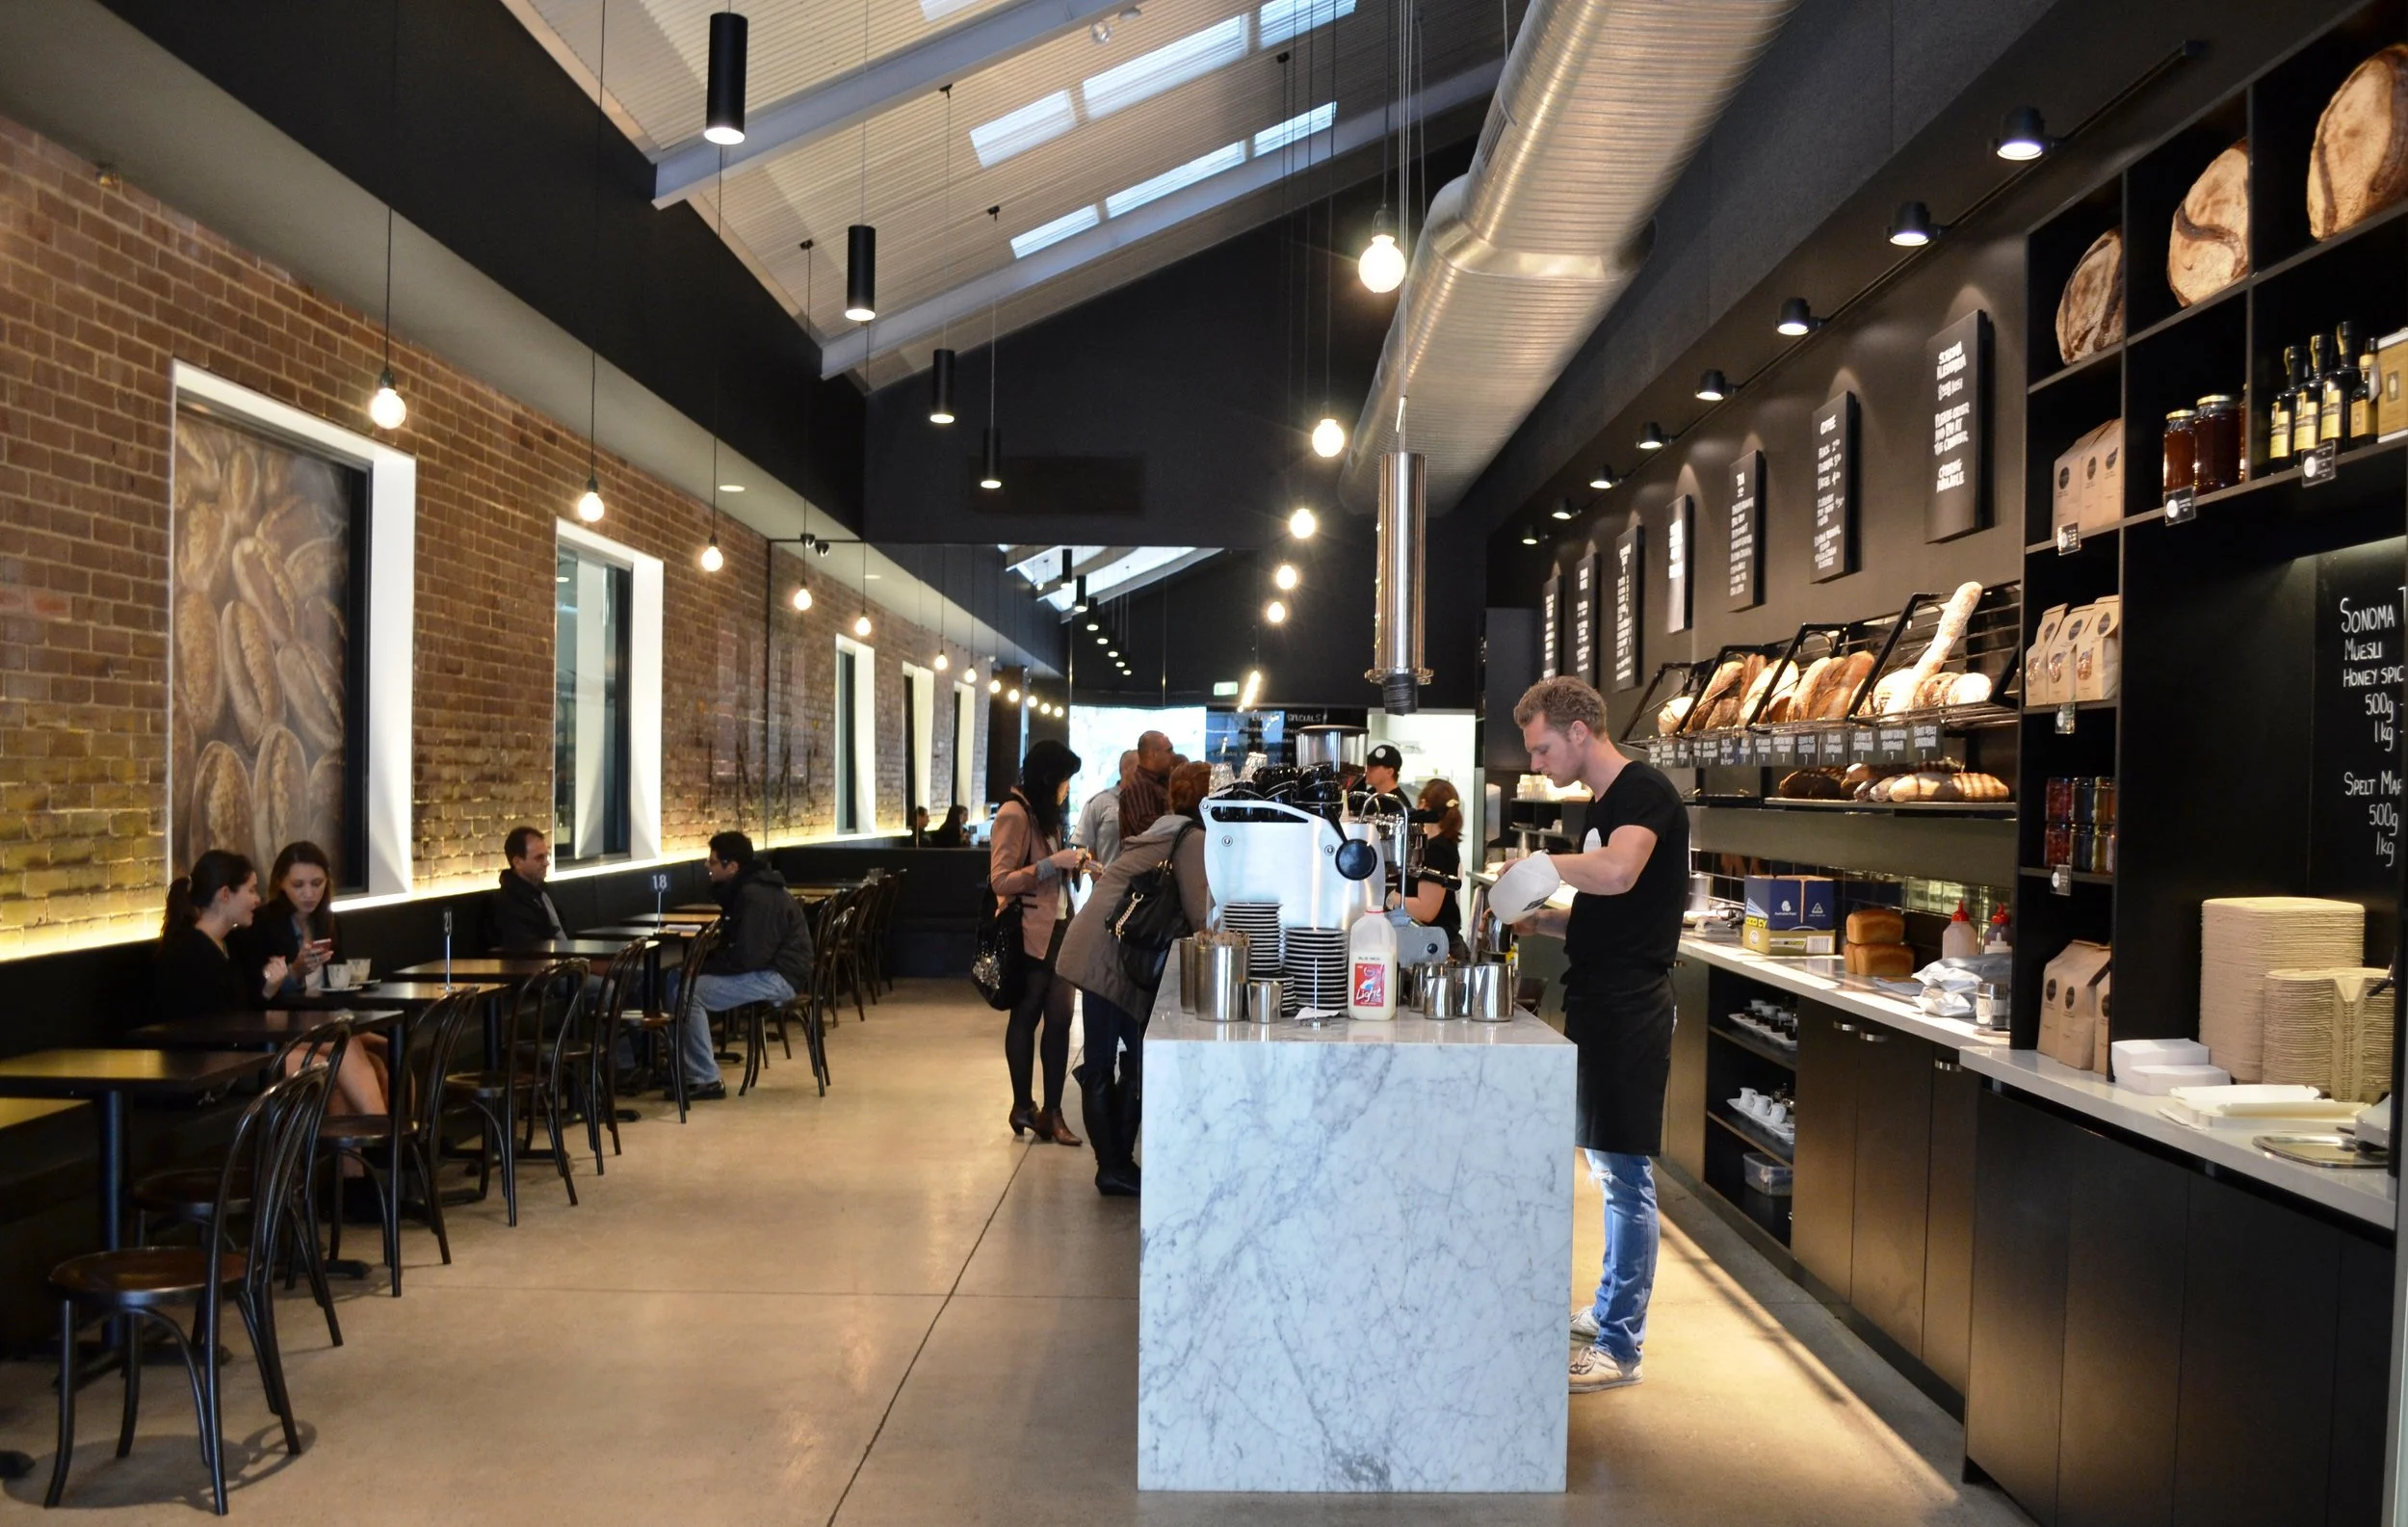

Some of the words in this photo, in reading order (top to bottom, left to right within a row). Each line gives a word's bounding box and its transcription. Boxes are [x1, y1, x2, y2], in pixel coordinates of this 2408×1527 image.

[2340, 597, 2395, 633] SONOMA
[2344, 638, 2382, 661] MUESLI
[2343, 668, 2378, 687] HONEY
[2365, 692, 2394, 724] 500g
[2374, 720, 2394, 751] 1kg
[2343, 772, 2376, 796] SPELT
[2369, 803, 2398, 836] 500g
[2375, 831, 2395, 867] 1kg
[652, 874, 667, 889] 18
